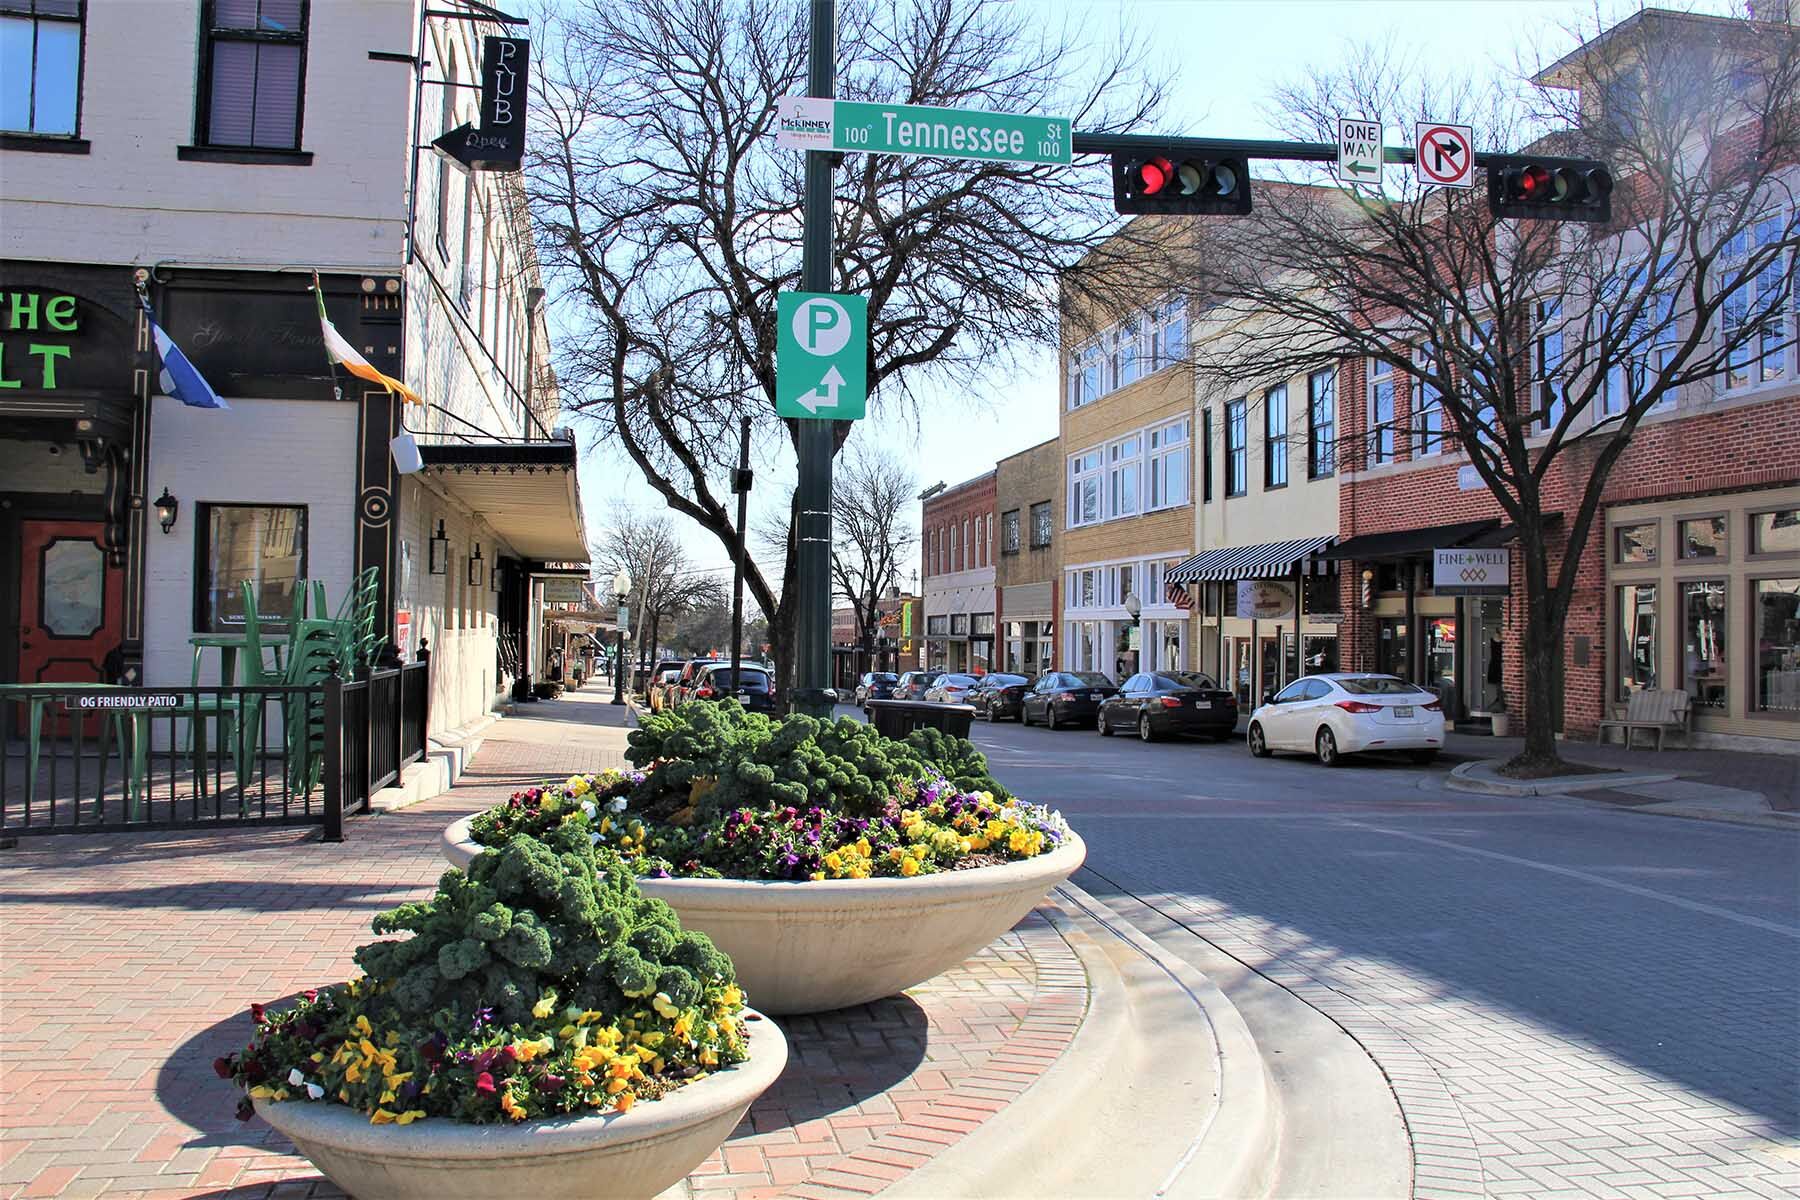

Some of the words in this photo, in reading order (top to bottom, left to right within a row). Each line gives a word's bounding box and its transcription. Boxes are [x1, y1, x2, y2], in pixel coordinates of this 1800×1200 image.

[493, 41, 517, 124] PUB
[781, 117, 831, 129] McKINNEY
[465, 132, 510, 150] Open
[844, 127, 868, 144] 100
[882, 112, 1025, 154] Tennessee
[1047, 123, 1062, 140] St
[1344, 124, 1377, 141] ONE
[1037, 141, 1060, 157] 100
[1343, 141, 1378, 159] WAY
[808, 304, 840, 349] P
[97, 695, 147, 708] FRIENDLY
[147, 695, 177, 707] PATIO
